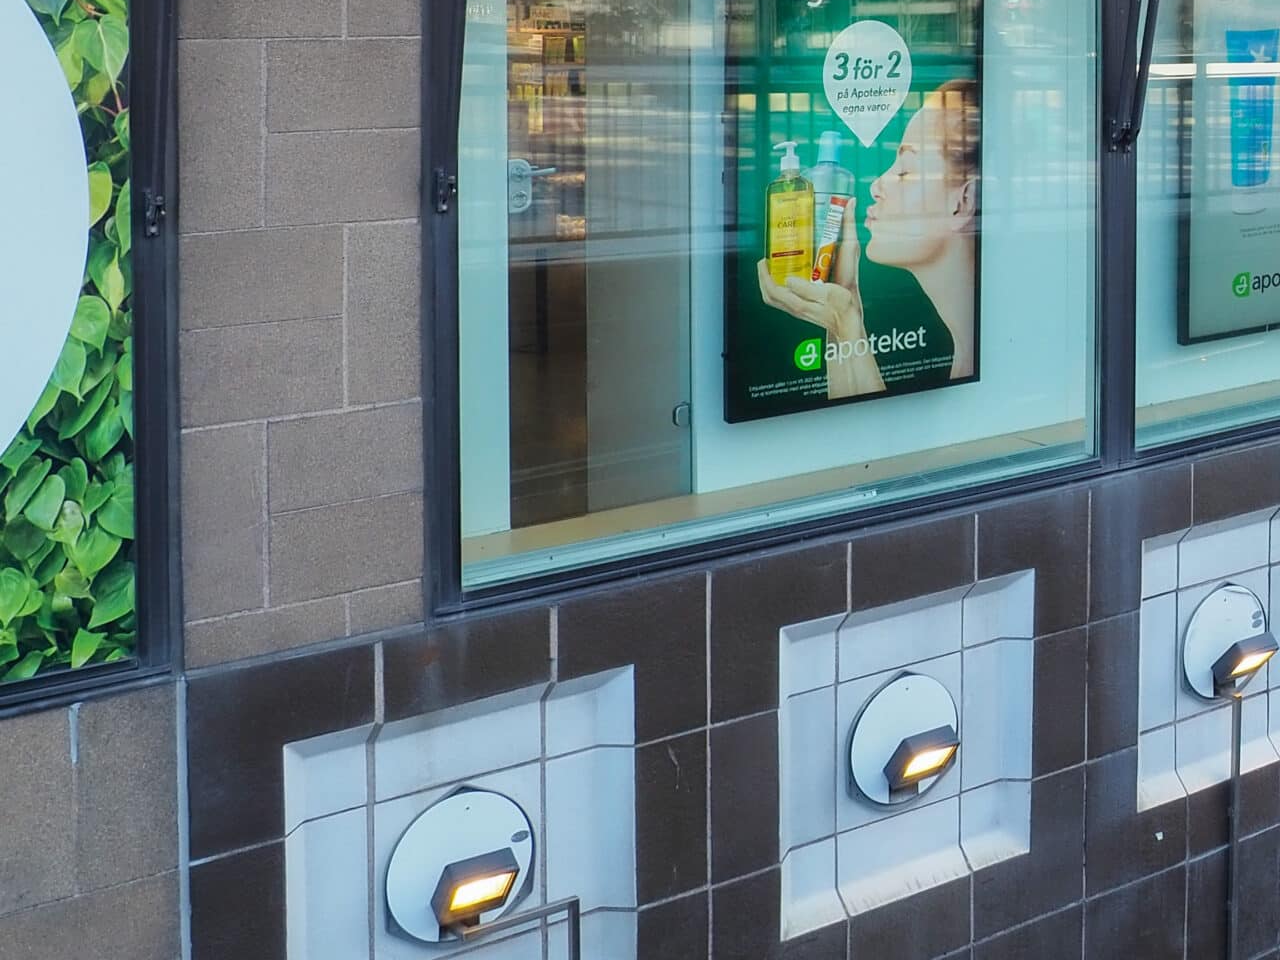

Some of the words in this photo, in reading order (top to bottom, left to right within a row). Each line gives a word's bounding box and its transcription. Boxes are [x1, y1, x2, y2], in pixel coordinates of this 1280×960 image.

[832, 52, 850, 81] 3
[853, 57, 884, 80] för
[886, 50, 902, 78] 2
[837, 87, 849, 101] på
[851, 85, 897, 100] Apotekets
[842, 104, 865, 115] egna
[867, 103, 891, 112] varor
[824, 326, 927, 365] apoteket
